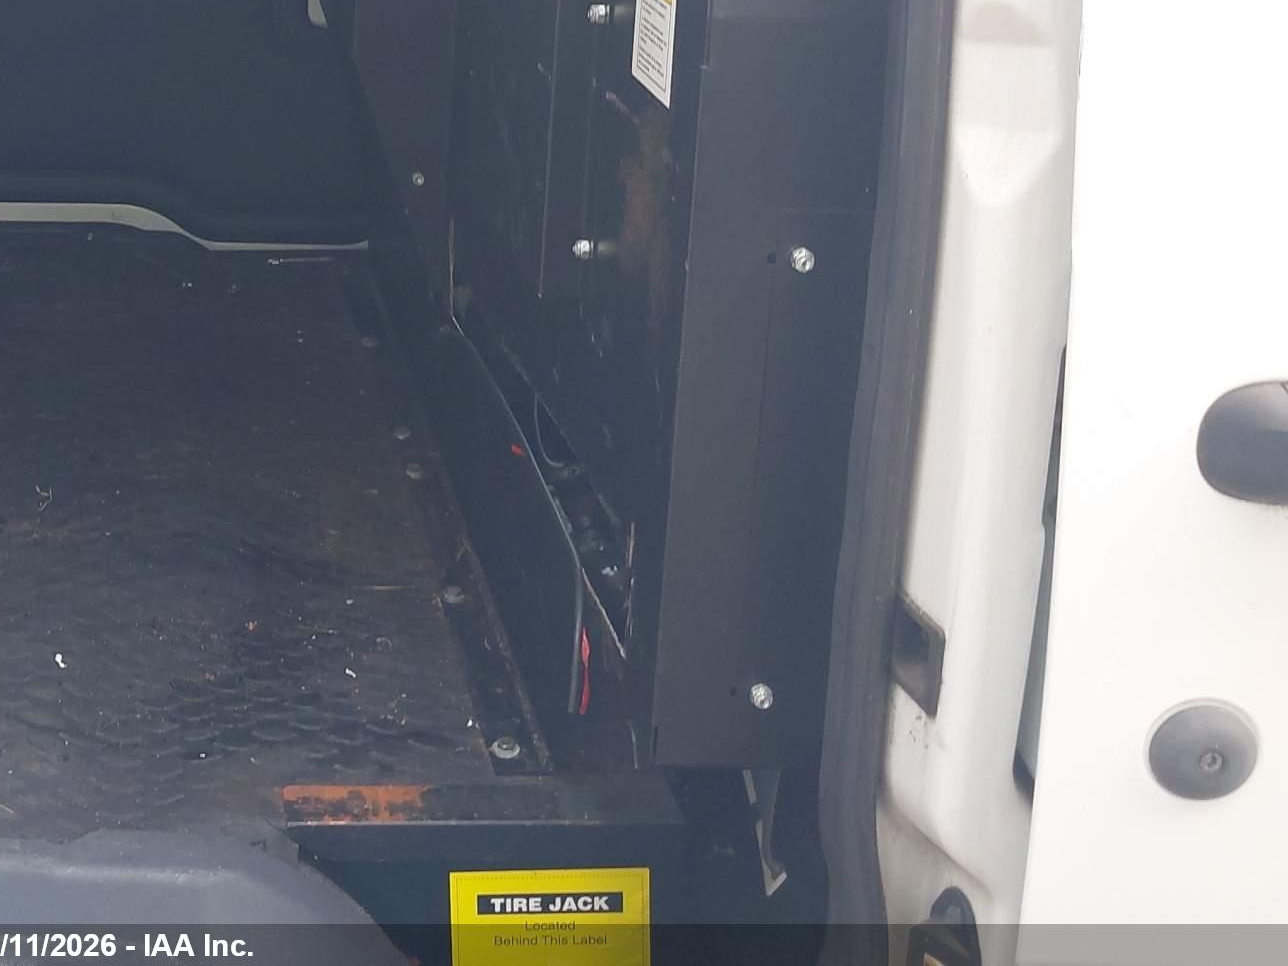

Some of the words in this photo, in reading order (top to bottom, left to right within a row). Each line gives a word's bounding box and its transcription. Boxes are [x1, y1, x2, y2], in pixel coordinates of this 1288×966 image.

[490, 897, 542, 913] TIRE
[549, 895, 610, 911] JACK
[524, 921, 576, 931] Located
[494, 935, 538, 946] Behind
[542, 935, 568, 946] This
[572, 935, 607, 945] Label
